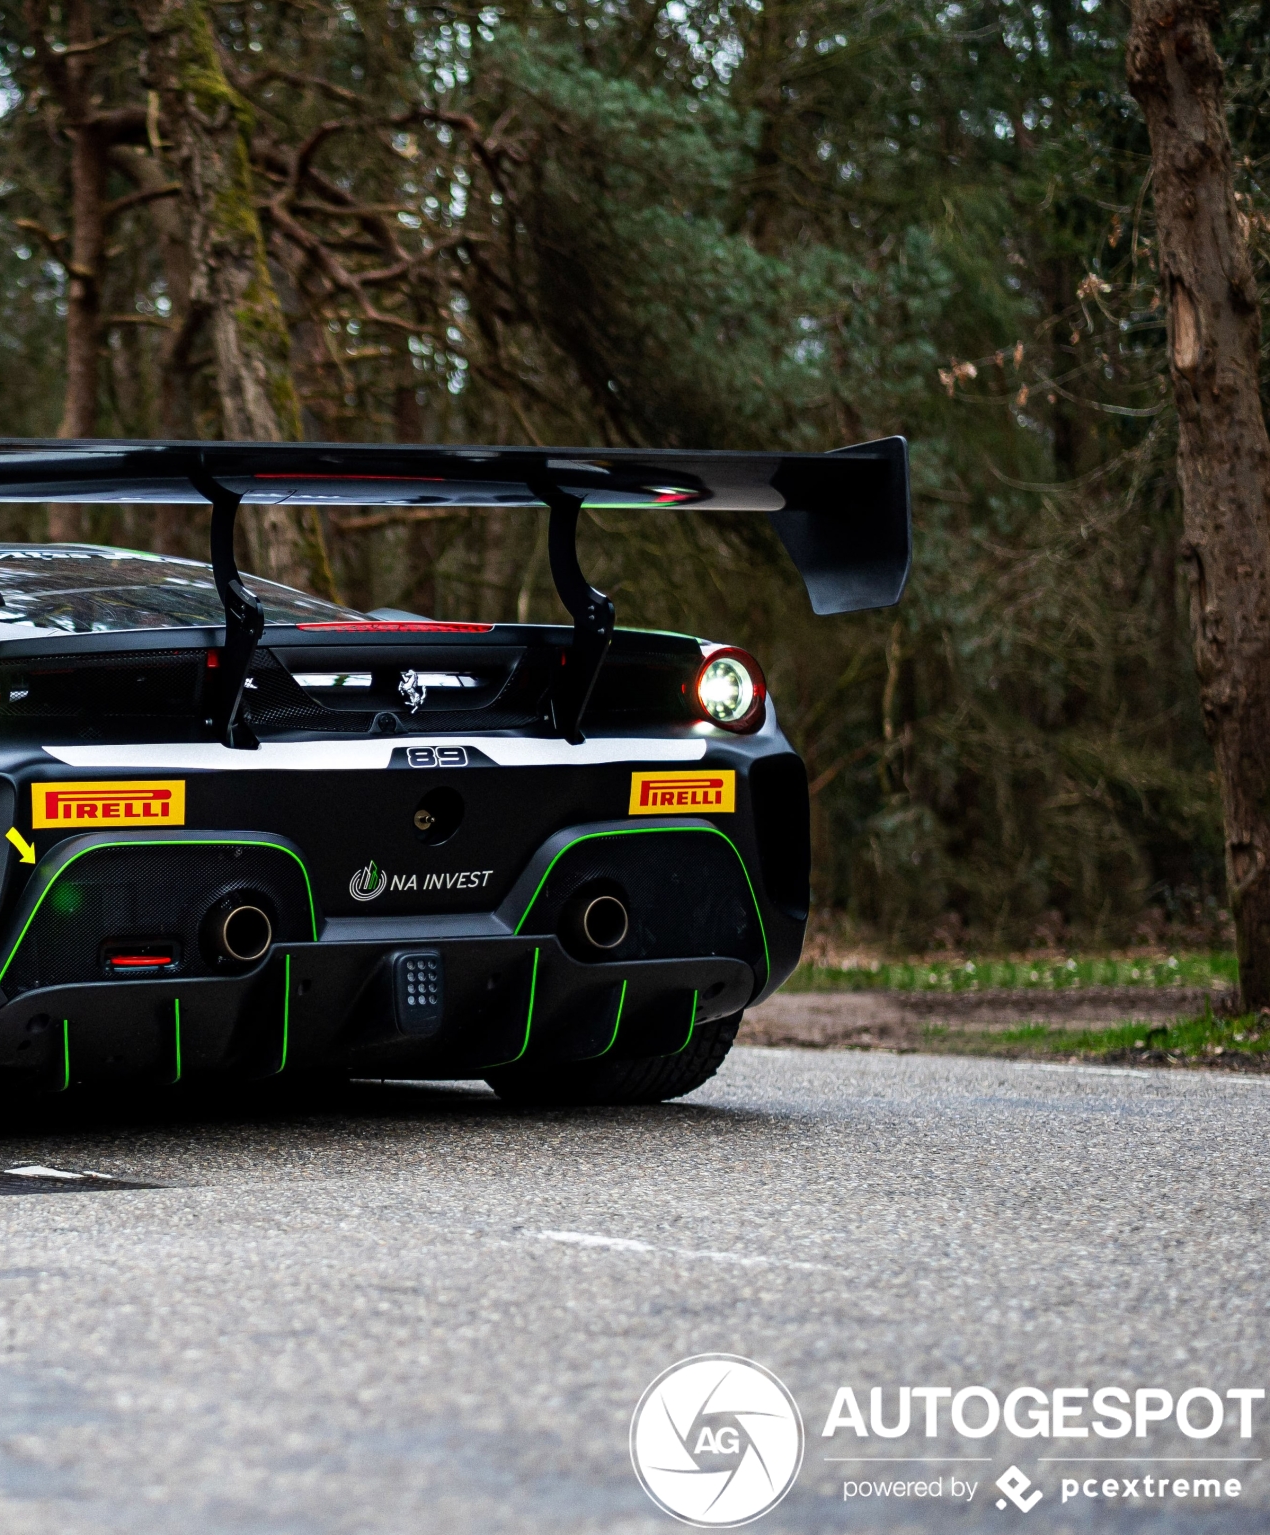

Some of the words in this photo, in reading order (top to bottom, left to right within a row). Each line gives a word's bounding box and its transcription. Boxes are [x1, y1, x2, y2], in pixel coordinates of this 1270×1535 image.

[407, 745, 468, 768] 89
[45, 789, 172, 819] PIRELLI
[640, 779, 724, 806] PIRELLI
[390, 874, 417, 891] NA
[423, 870, 494, 891] INVEST
